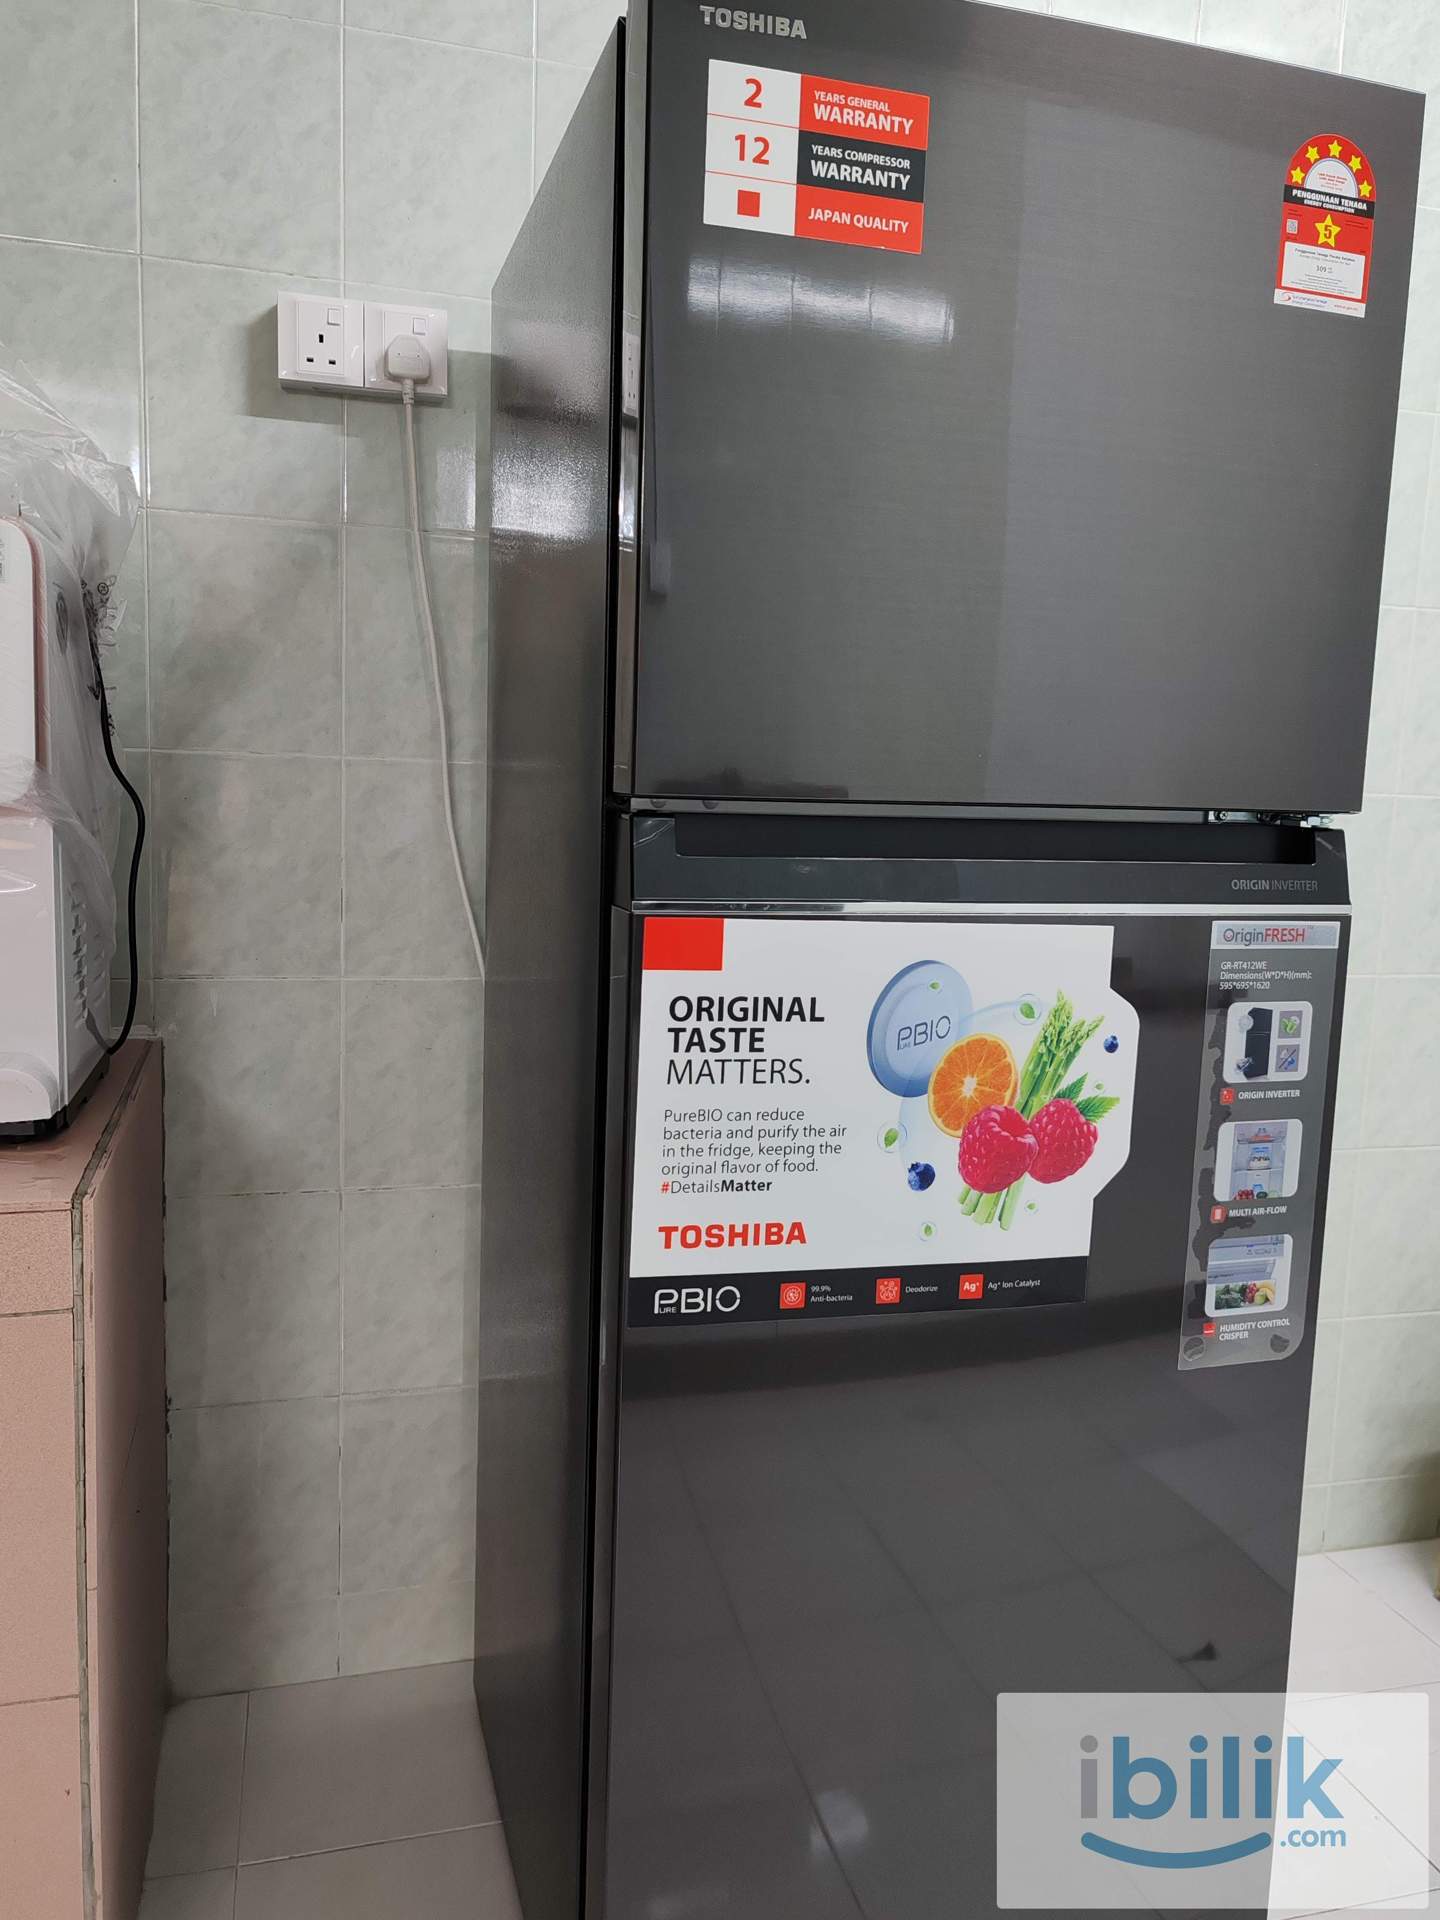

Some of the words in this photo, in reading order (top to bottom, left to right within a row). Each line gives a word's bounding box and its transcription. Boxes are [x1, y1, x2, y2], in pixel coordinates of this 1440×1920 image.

[700, 5, 807, 39] TOSHIBA
[743, 78, 762, 109] 2
[814, 90, 847, 103] YEARS
[848, 97, 890, 112] GENERAL
[813, 103, 913, 135] WARRANTY
[734, 134, 770, 165] 12
[811, 144, 843, 159] YEARS
[845, 150, 910, 170] COMPRESSOR
[810, 159, 911, 191] WARRANTY
[1292, 189, 1339, 204] PENGGUNAAN
[1341, 198, 1367, 211] TENAGA
[808, 208, 850, 225] JAPAN
[853, 214, 909, 233] QUALITY
[1323, 224, 1333, 237] 5
[1231, 879, 1270, 890] ORIGIN
[1271, 880, 1318, 891] INVERTER
[1221, 961, 1267, 970] GR-RT412WE
[669, 995, 825, 1022] ORIGINAL
[667, 1027, 765, 1053] TASTE
[667, 1058, 810, 1085] MATTERS.
[1238, 1090, 1264, 1100] ORIGIN
[1265, 1089, 1300, 1099] INVERTER
[664, 1109, 723, 1122] PureBIO
[727, 1110, 751, 1121] can
[756, 1108, 805, 1121] reduce
[663, 1127, 722, 1140] bacteria
[726, 1125, 753, 1139] and
[757, 1124, 799, 1141] purify
[803, 1125, 826, 1138] the
[829, 1124, 847, 1137] air
[662, 1144, 675, 1158] in
[680, 1144, 704, 1157] the
[708, 1143, 754, 1159] fridge,
[758, 1142, 815, 1158] keeping
[819, 1141, 842, 1154] the
[661, 1161, 717, 1178] original
[721, 1160, 761, 1174] flavor
[765, 1159, 779, 1173] of
[782, 1158, 818, 1172] food.
[660, 1179, 773, 1194] #DetailsMatter
[1228, 1208, 1251, 1217] MULTI
[1252, 1206, 1287, 1216] AIR-FLOW
[658, 1221, 807, 1249] TOSHIBA
[905, 1285, 939, 1294] Deodorize
[1014, 1279, 1041, 1288] Catalyst
[810, 1294, 853, 1303] Anti-bacteria
[1220, 1321, 1256, 1332] HUMIDITY
[1257, 1318, 1290, 1328] CONTROL
[1219, 1331, 1249, 1341] CRISPER
